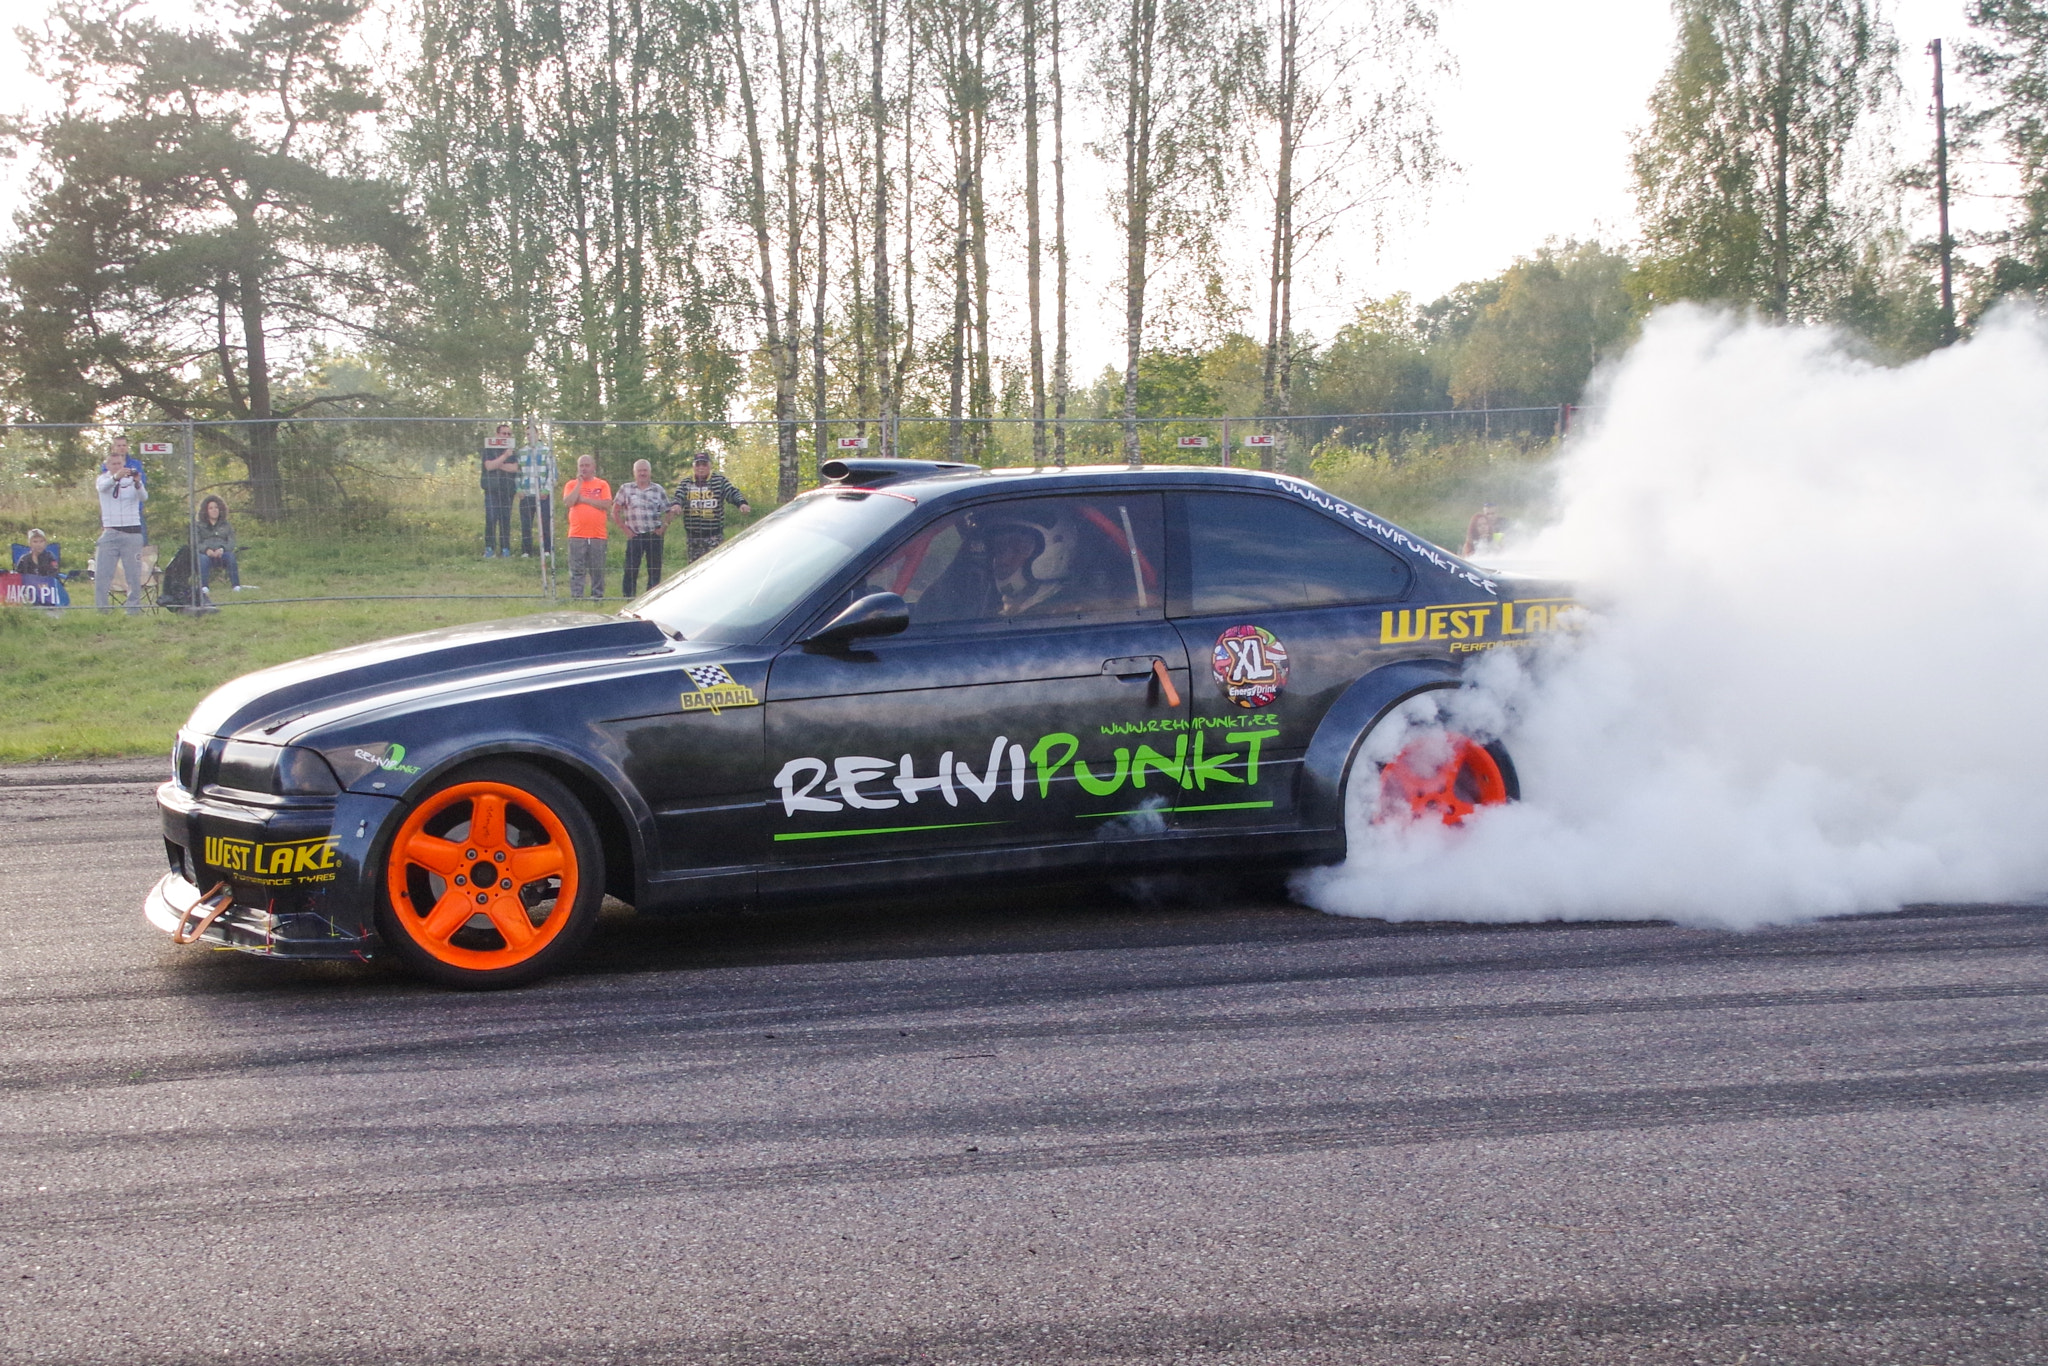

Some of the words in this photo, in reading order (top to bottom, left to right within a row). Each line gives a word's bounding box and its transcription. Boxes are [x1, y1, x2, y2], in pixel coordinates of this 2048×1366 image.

[1380, 608, 1490, 645] WEST
[1502, 601, 1588, 636] LAK
[1226, 639, 1273, 681] XL
[683, 690, 756, 708] BARDAHL
[205, 836, 251, 871] WEST
[254, 842, 340, 874] LAKE
[297, 872, 336, 884] TYRES
